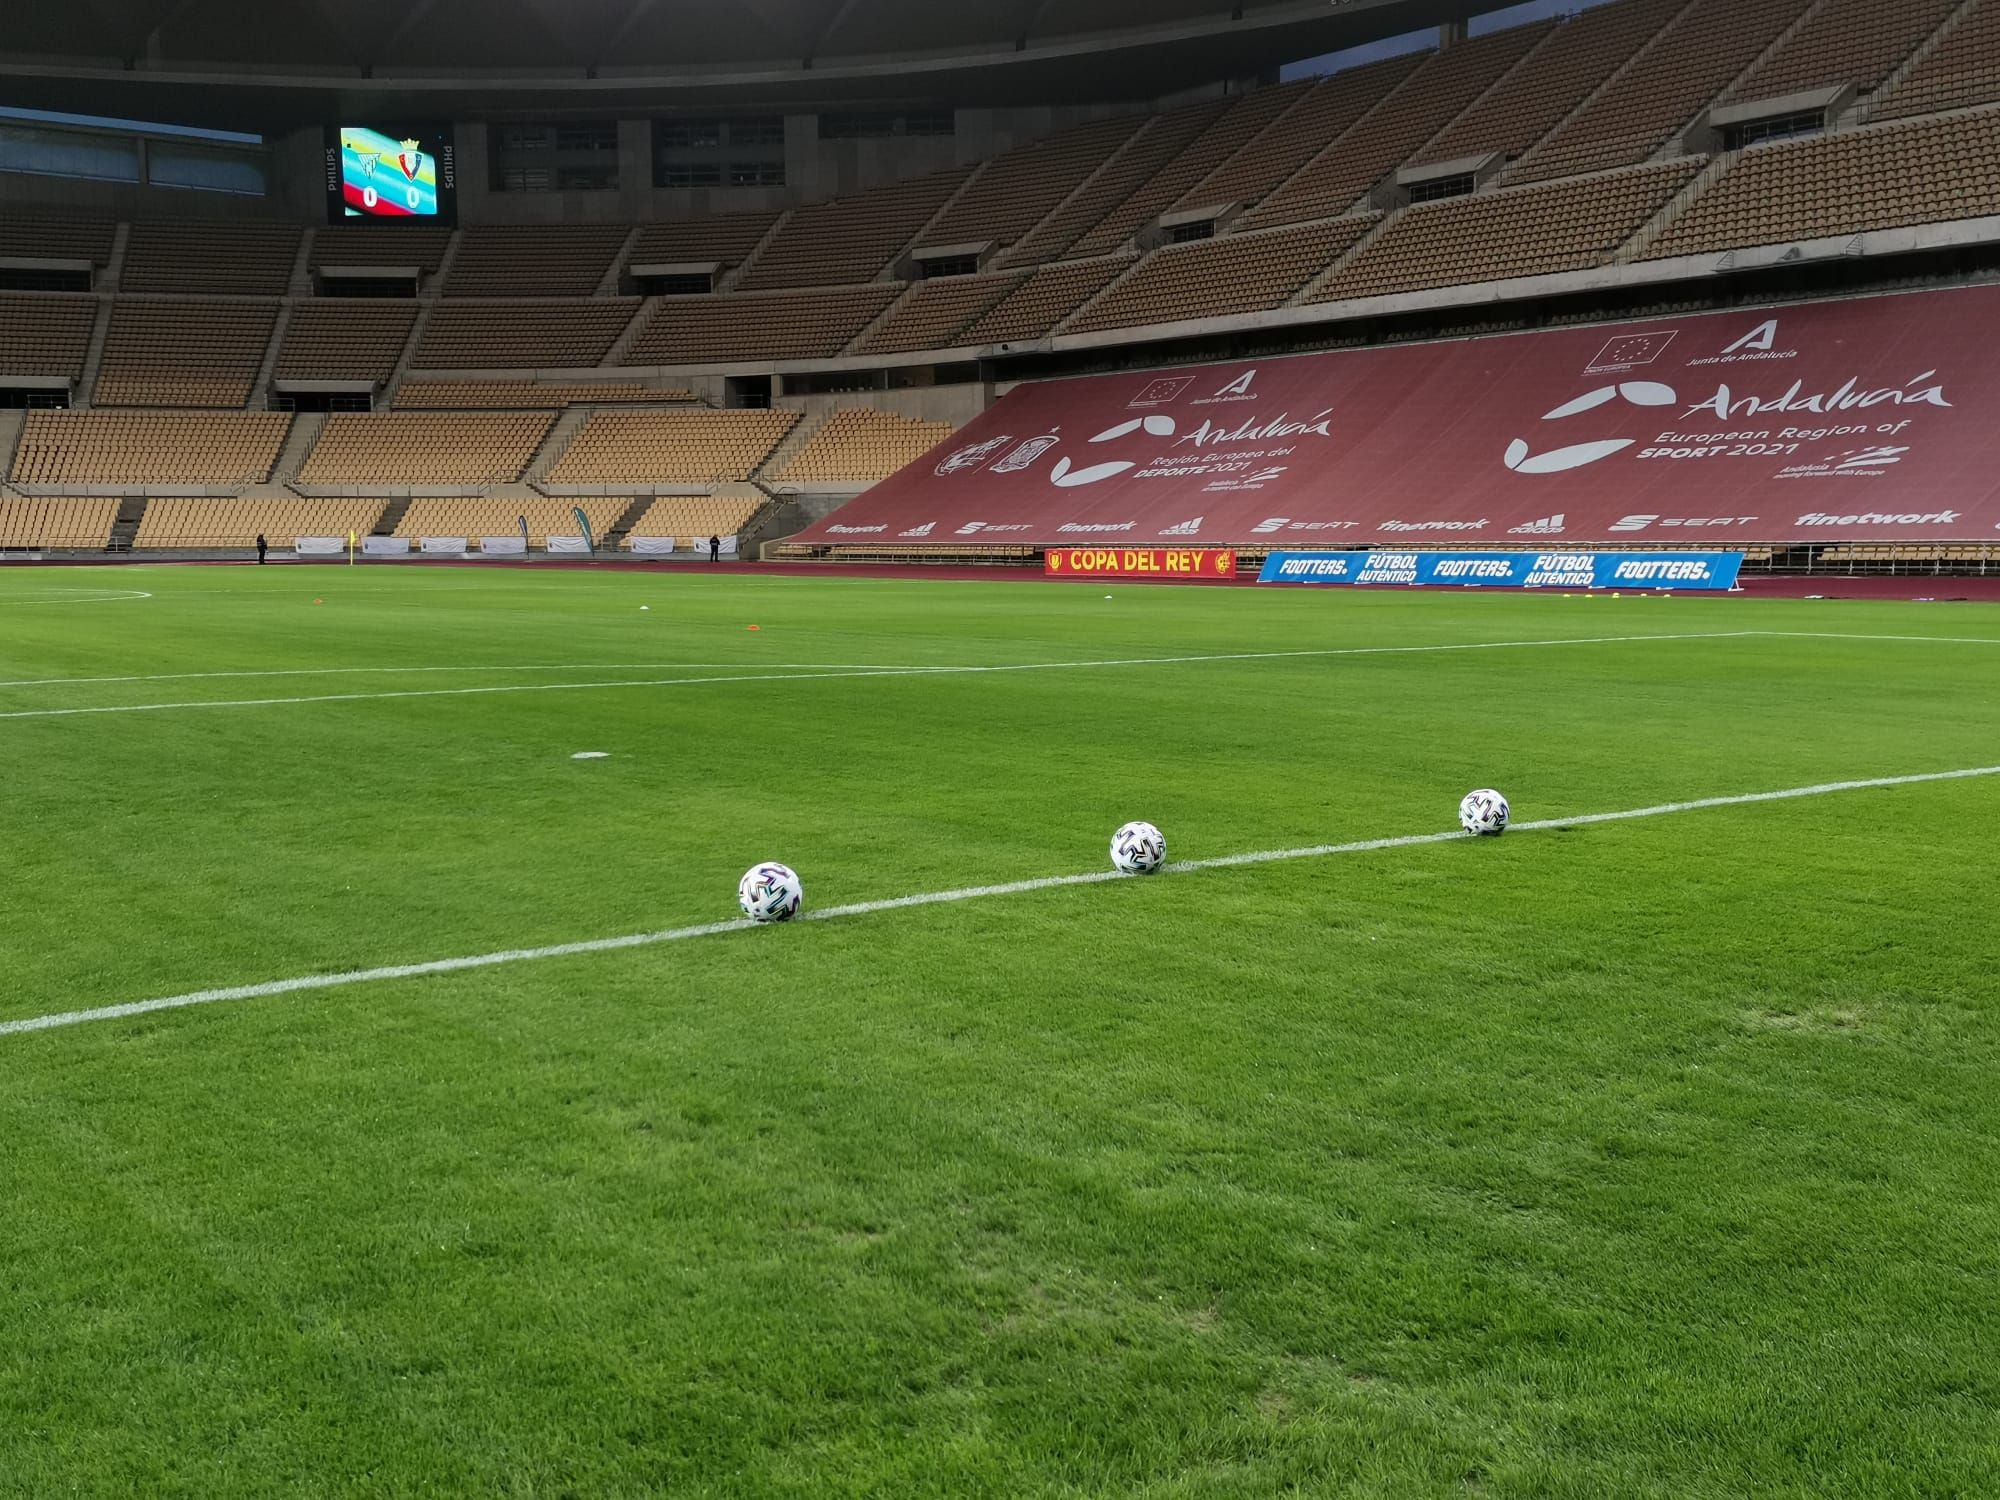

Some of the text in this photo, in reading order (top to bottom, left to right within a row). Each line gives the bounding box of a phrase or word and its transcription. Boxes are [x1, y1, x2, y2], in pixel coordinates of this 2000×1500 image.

[326, 148, 337, 191] PHILIPS
[443, 145, 454, 189] PHILIPS
[363, 186, 420, 208] 0 0
[1686, 349, 1798, 367] Junta de Andalucía
[1678, 369, 1953, 420] Andalucía
[1171, 408, 1334, 448] Andalucía
[1653, 419, 1913, 446] European Region of
[1150, 446, 1297, 467] Región Europea del
[1636, 443, 1801, 460] SPORT 2021
[1133, 462, 1252, 479] DEPORTE 2021
[1056, 520, 1139, 533] finetwork
[1287, 521, 1361, 530] SEAT
[1376, 518, 1491, 532] finetwork
[1658, 516, 1760, 526] SEAT
[1794, 510, 1963, 526] finetwork
[825, 523, 889, 534] finetwork
[981, 524, 1034, 532] SEAT
[1507, 525, 1566, 534] adidas
[1070, 550, 1204, 572] COPA DEL REY
[1279, 559, 1348, 575] FOOTTERS.
[1364, 552, 1419, 569] FÚTBOL
[1433, 560, 1513, 577] FOOTTERS.
[1533, 553, 1595, 571] FÚTBOL
[1356, 567, 1418, 582] AUTÉNTICO
[1524, 569, 1595, 585] AUTÉNTICO
[1614, 561, 1711, 580] FOOTTERS.
